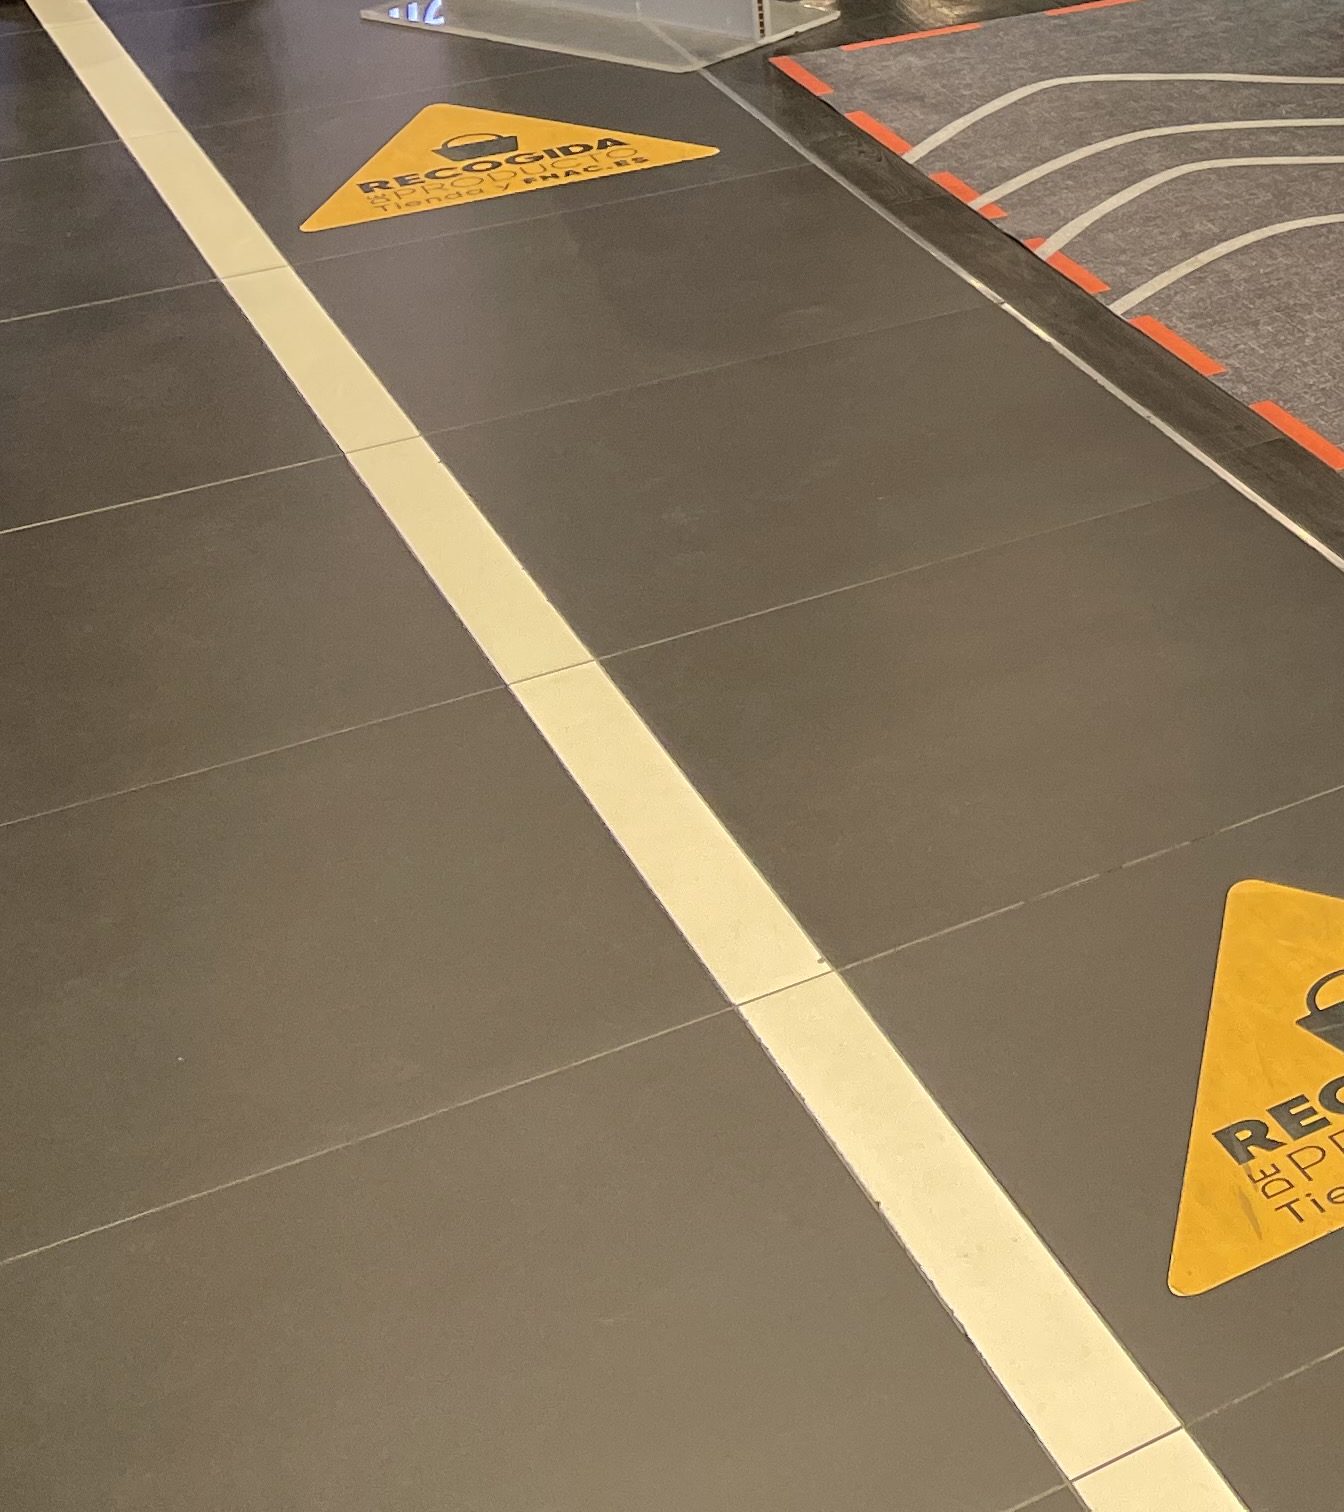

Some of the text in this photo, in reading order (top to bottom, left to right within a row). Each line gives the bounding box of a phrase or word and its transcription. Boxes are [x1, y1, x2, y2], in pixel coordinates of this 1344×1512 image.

[357, 136, 630, 194] RECOGIDA
[373, 186, 485, 212] Tienda
[522, 156, 649, 185] FNAC.ES
[392, 147, 639, 201] PRODUCTO
[1249, 1162, 1295, 1201] DE
